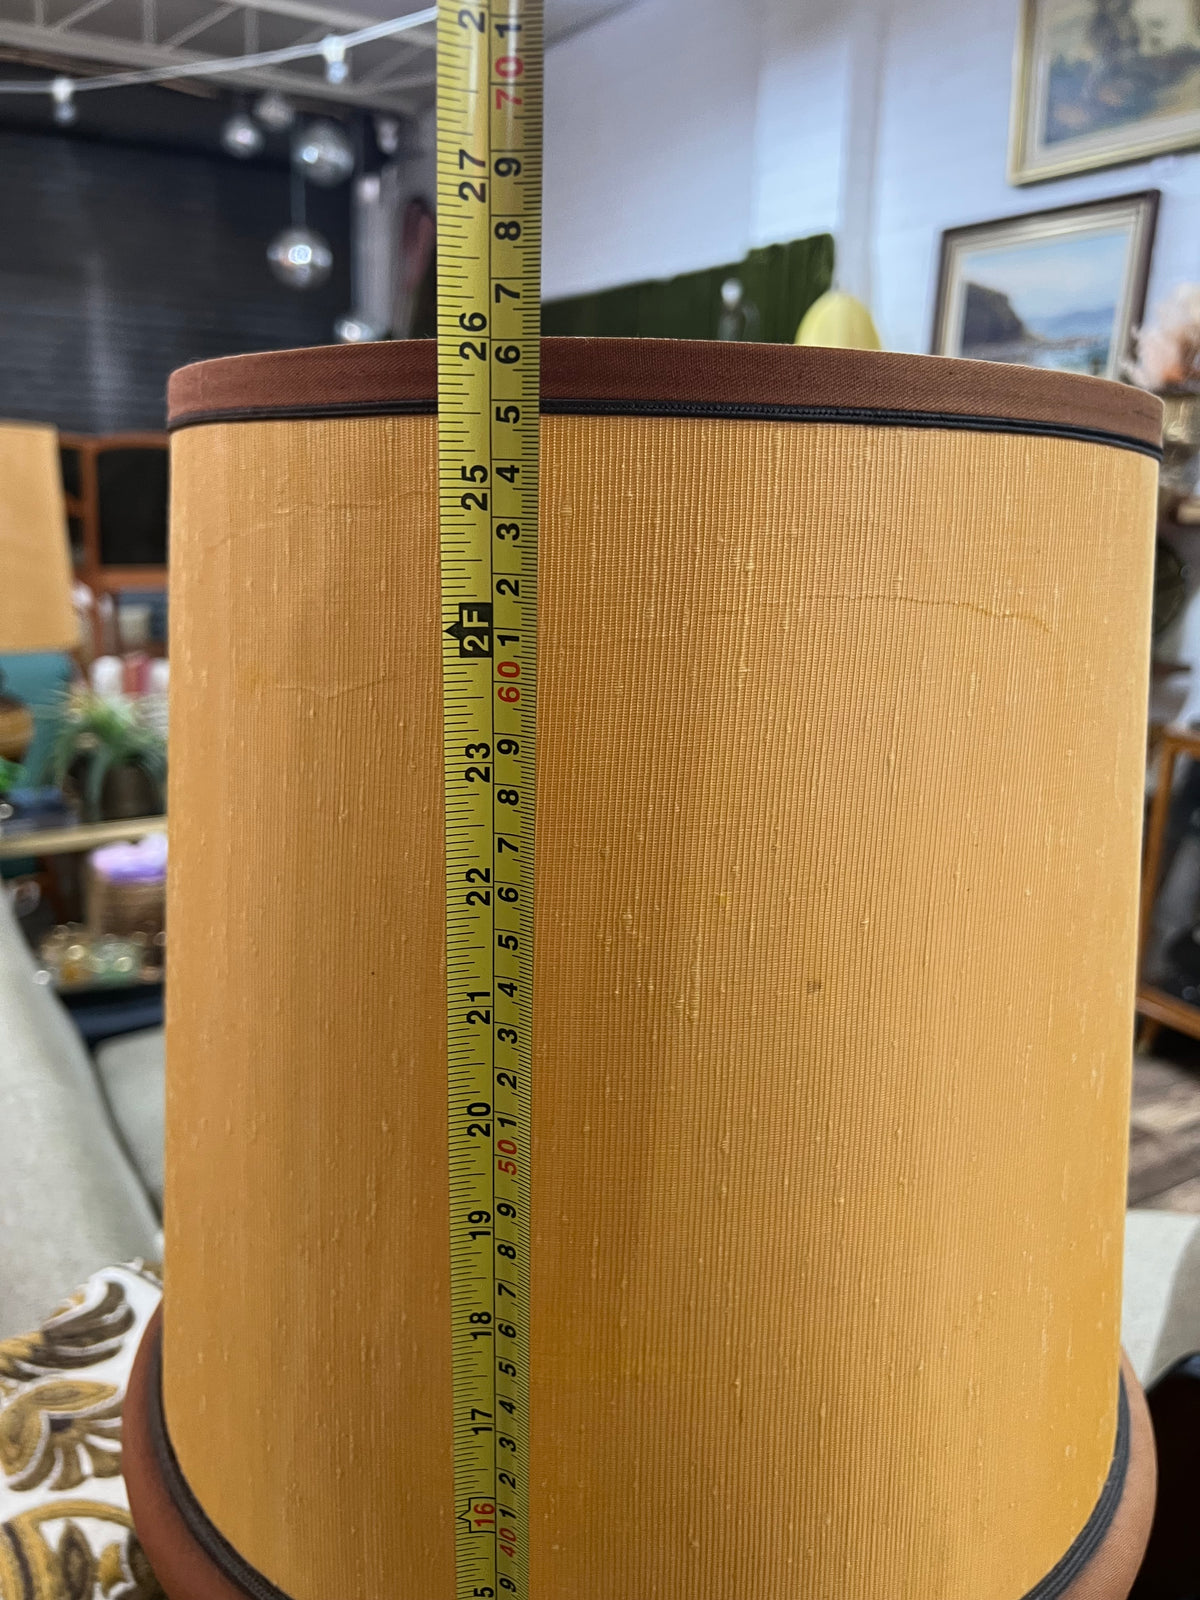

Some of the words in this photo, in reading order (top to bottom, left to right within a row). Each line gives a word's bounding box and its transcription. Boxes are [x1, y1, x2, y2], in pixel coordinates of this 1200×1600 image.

[494, 24, 522, 38] 1
[495, 56, 524, 109] 70
[458, 149, 486, 203] 27
[494, 157, 522, 177] 9
[494, 221, 522, 241] 8
[495, 284, 521, 303] 7
[459, 312, 487, 361] 26
[495, 345, 521, 364] 6
[495, 405, 520, 424] 5
[495, 465, 520, 483] 4
[461, 465, 488, 511] 25
[496, 523, 520, 540] 3
[496, 579, 520, 596] 2
[463, 610, 489, 652] 2F
[497, 635, 520, 646] 1
[497, 661, 521, 703] 60
[497, 739, 520, 755] 9
[465, 742, 490, 783] 23
[497, 789, 520, 806] 8
[498, 838, 519, 853] 7
[466, 868, 490, 906] 22
[498, 887, 519, 902] 6
[498, 935, 518, 950] 5
[498, 982, 518, 997] 4
[466, 992, 490, 1024] 21
[497, 1028, 518, 1044] 3
[497, 1072, 517, 1090] 2
[467, 1102, 491, 1137] 20
[497, 1117, 517, 1128] 1
[497, 1140, 517, 1176] 50
[497, 1203, 517, 1218] 9
[468, 1210, 491, 1240] 19
[497, 1244, 517, 1259] 8
[498, 1283, 517, 1298] 7
[469, 1312, 492, 1340] 18
[498, 1324, 517, 1339] 6
[499, 1362, 516, 1377] 5
[499, 1400, 516, 1414] 4
[471, 1408, 492, 1435] 17
[499, 1437, 516, 1452] 3
[499, 1473, 516, 1489] 2
[474, 1503, 495, 1527] 16
[500, 1508, 516, 1519] 1
[499, 1528, 517, 1558] 40
[499, 1578, 516, 1592] 9
